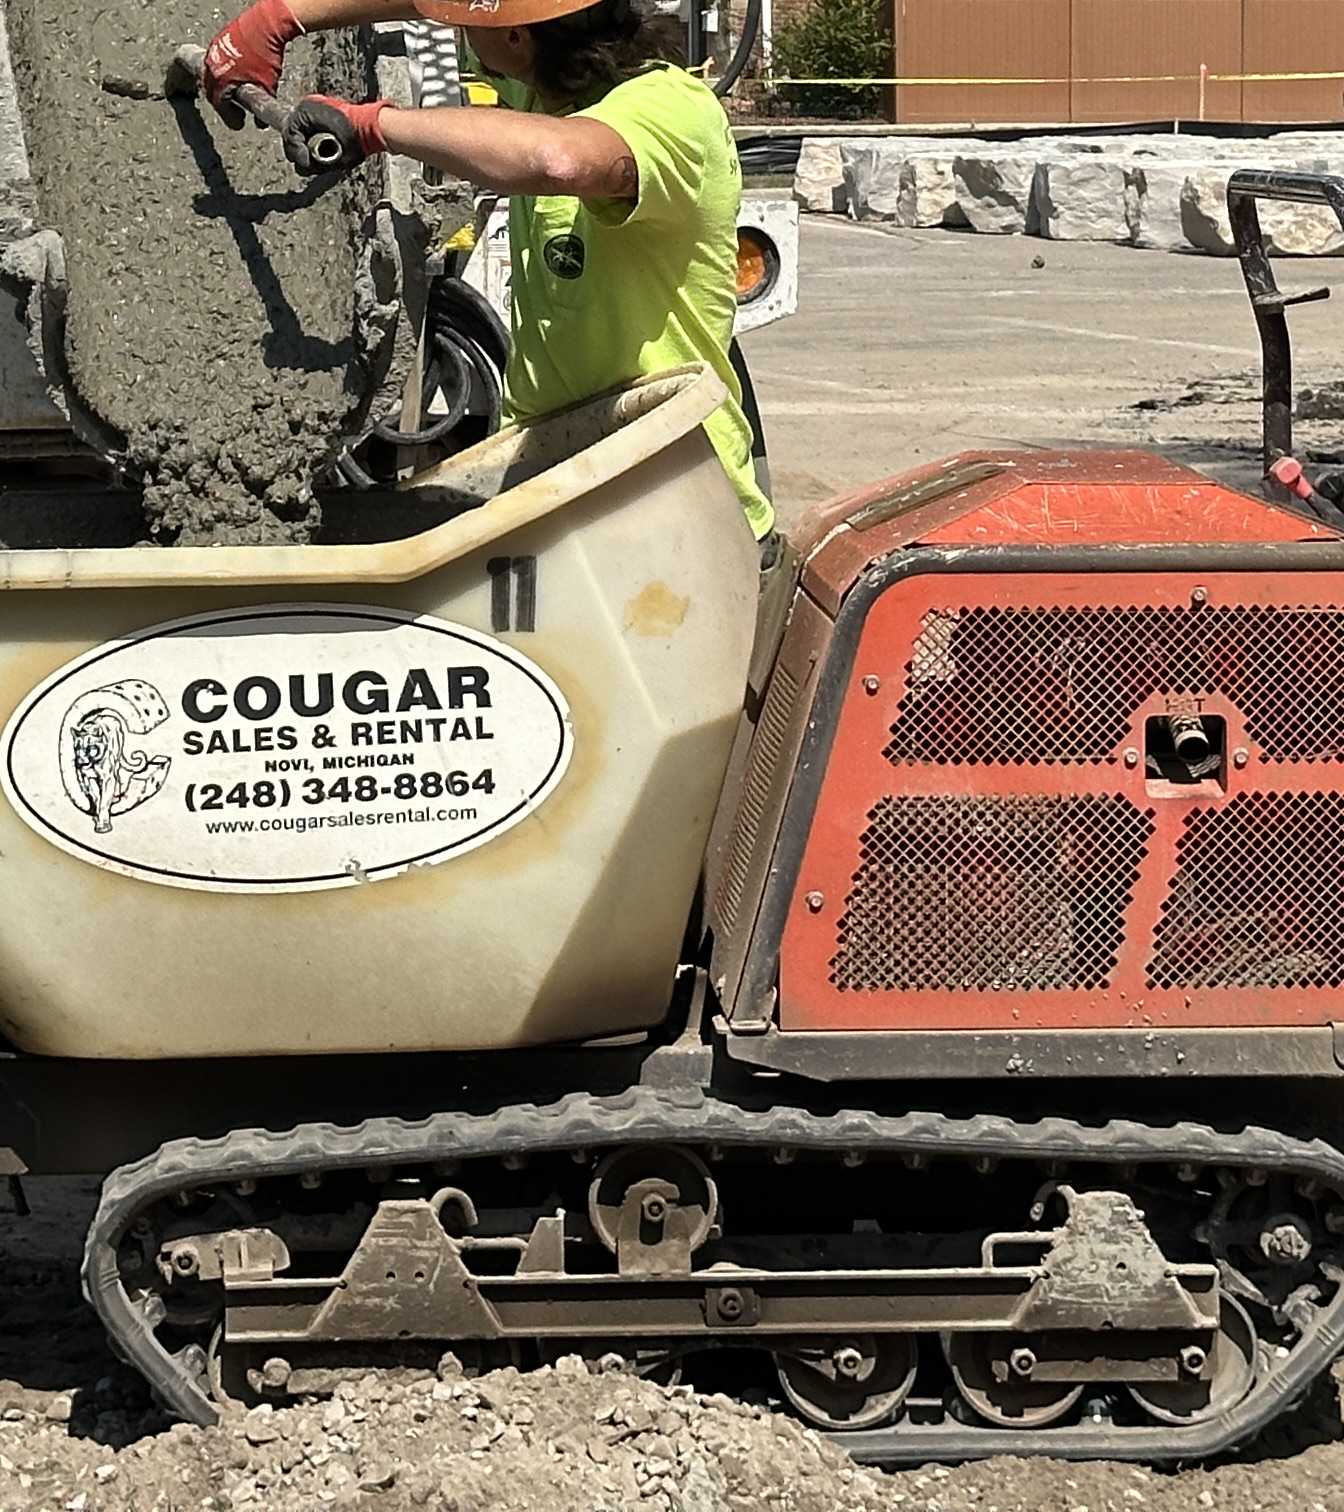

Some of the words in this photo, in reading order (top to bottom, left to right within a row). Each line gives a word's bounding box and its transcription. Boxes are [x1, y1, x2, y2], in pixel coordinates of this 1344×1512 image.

[181, 665, 493, 724] COUGAR
[182, 725, 299, 756] SALES
[311, 723, 338, 749] &
[351, 715, 495, 747] RENTAL
[264, 758, 315, 773] NOVI,
[322, 752, 415, 770] MICHIGAN
[184, 778, 292, 813] (248)
[301, 768, 497, 805] 348-8864
[206, 806, 478, 834] www.cougarsalesrental.com
